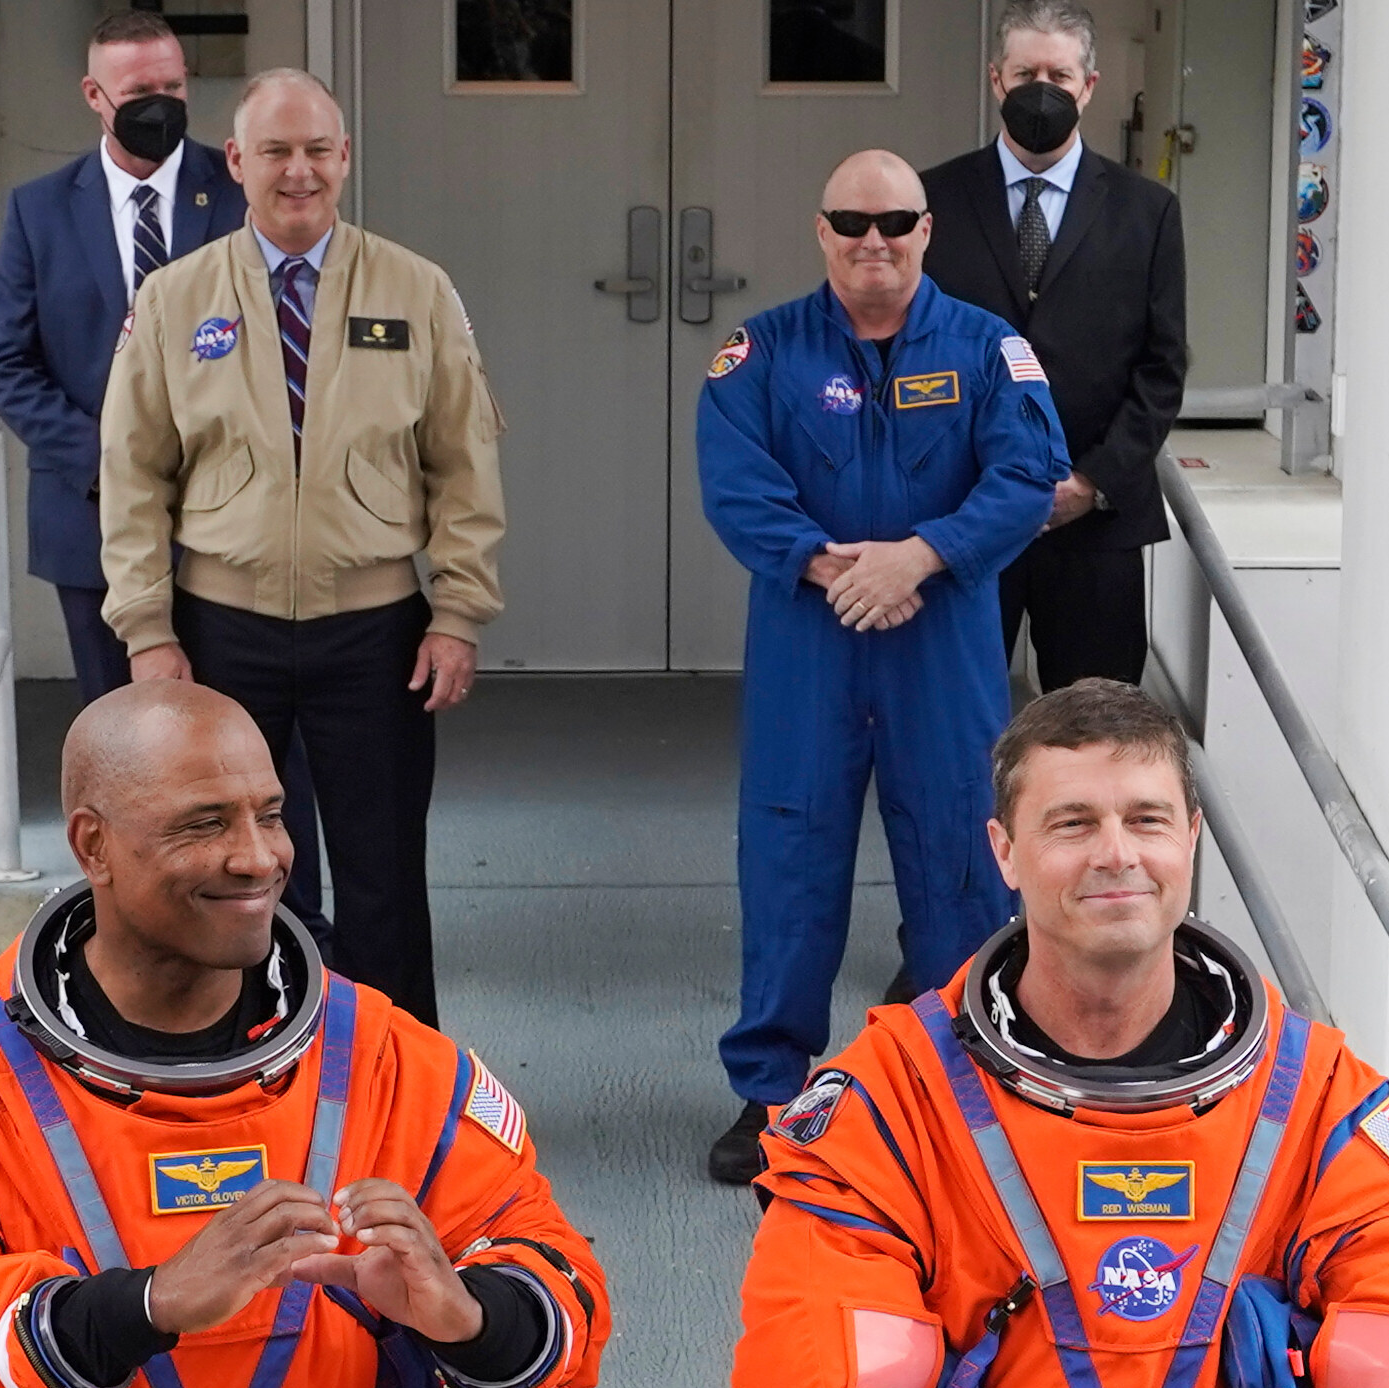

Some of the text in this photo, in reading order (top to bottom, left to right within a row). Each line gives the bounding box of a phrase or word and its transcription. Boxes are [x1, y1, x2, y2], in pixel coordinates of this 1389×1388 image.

[175, 1194, 207, 1206] VICTOR
[1127, 1203, 1170, 1214] WISEMAN
[1103, 1266, 1176, 1291] NASA
